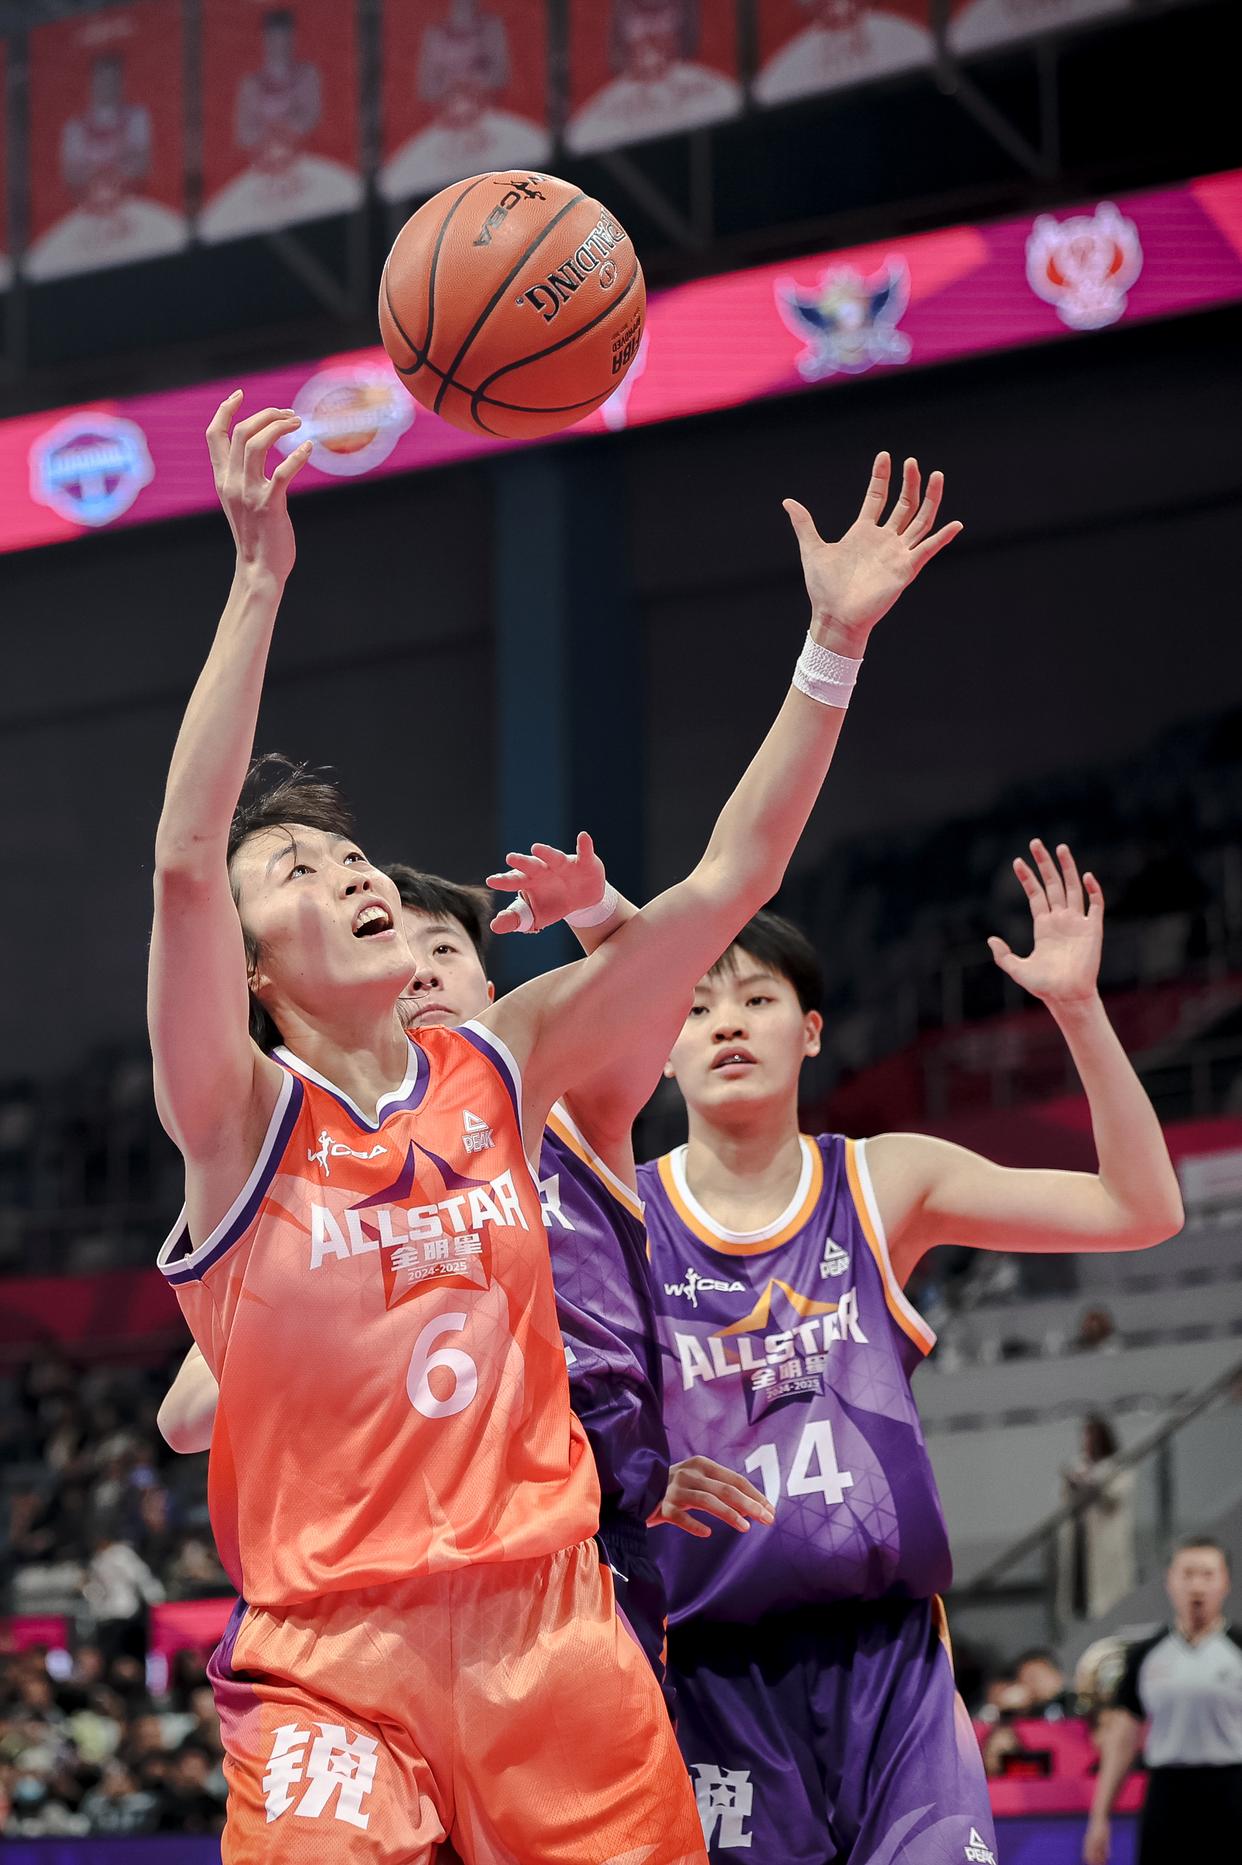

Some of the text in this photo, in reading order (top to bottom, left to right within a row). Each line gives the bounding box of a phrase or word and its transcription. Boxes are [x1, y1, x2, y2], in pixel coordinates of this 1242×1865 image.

[524, 207, 626, 323] PALDING
[461, 1129, 496, 1154] PEAK
[309, 1168, 530, 1271] ALLSTAR
[390, 1232, 483, 1272] 全明星
[407, 1261, 468, 1281] 2024-2025
[406, 1312, 478, 1419] 6
[674, 1286, 870, 1391] ALLSTAR
[744, 1420, 854, 1508] 14
[262, 1721, 379, 1830] 锐
